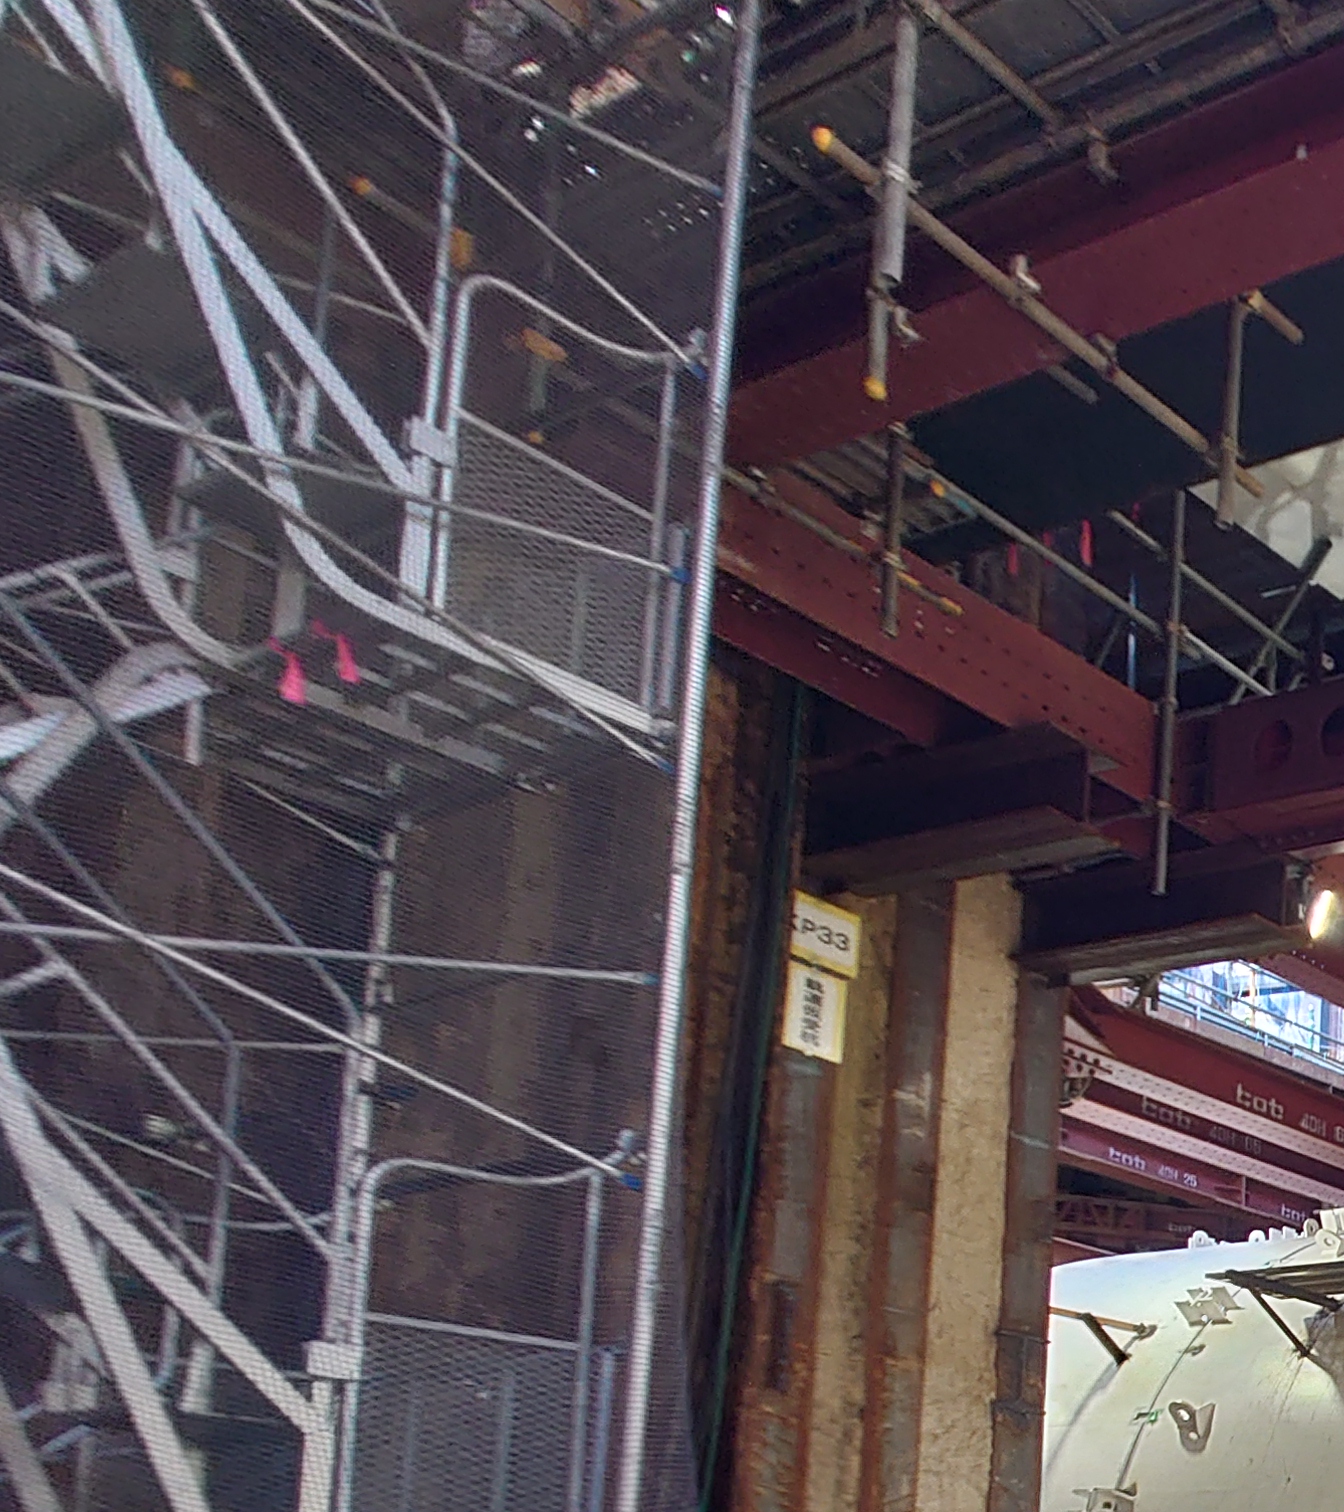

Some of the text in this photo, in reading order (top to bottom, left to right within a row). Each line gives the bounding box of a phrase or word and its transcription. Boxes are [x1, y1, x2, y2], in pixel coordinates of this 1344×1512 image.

[1236, 1082, 1284, 1119] ヒロセ
[1109, 1146, 1147, 1172] ヒロセ
